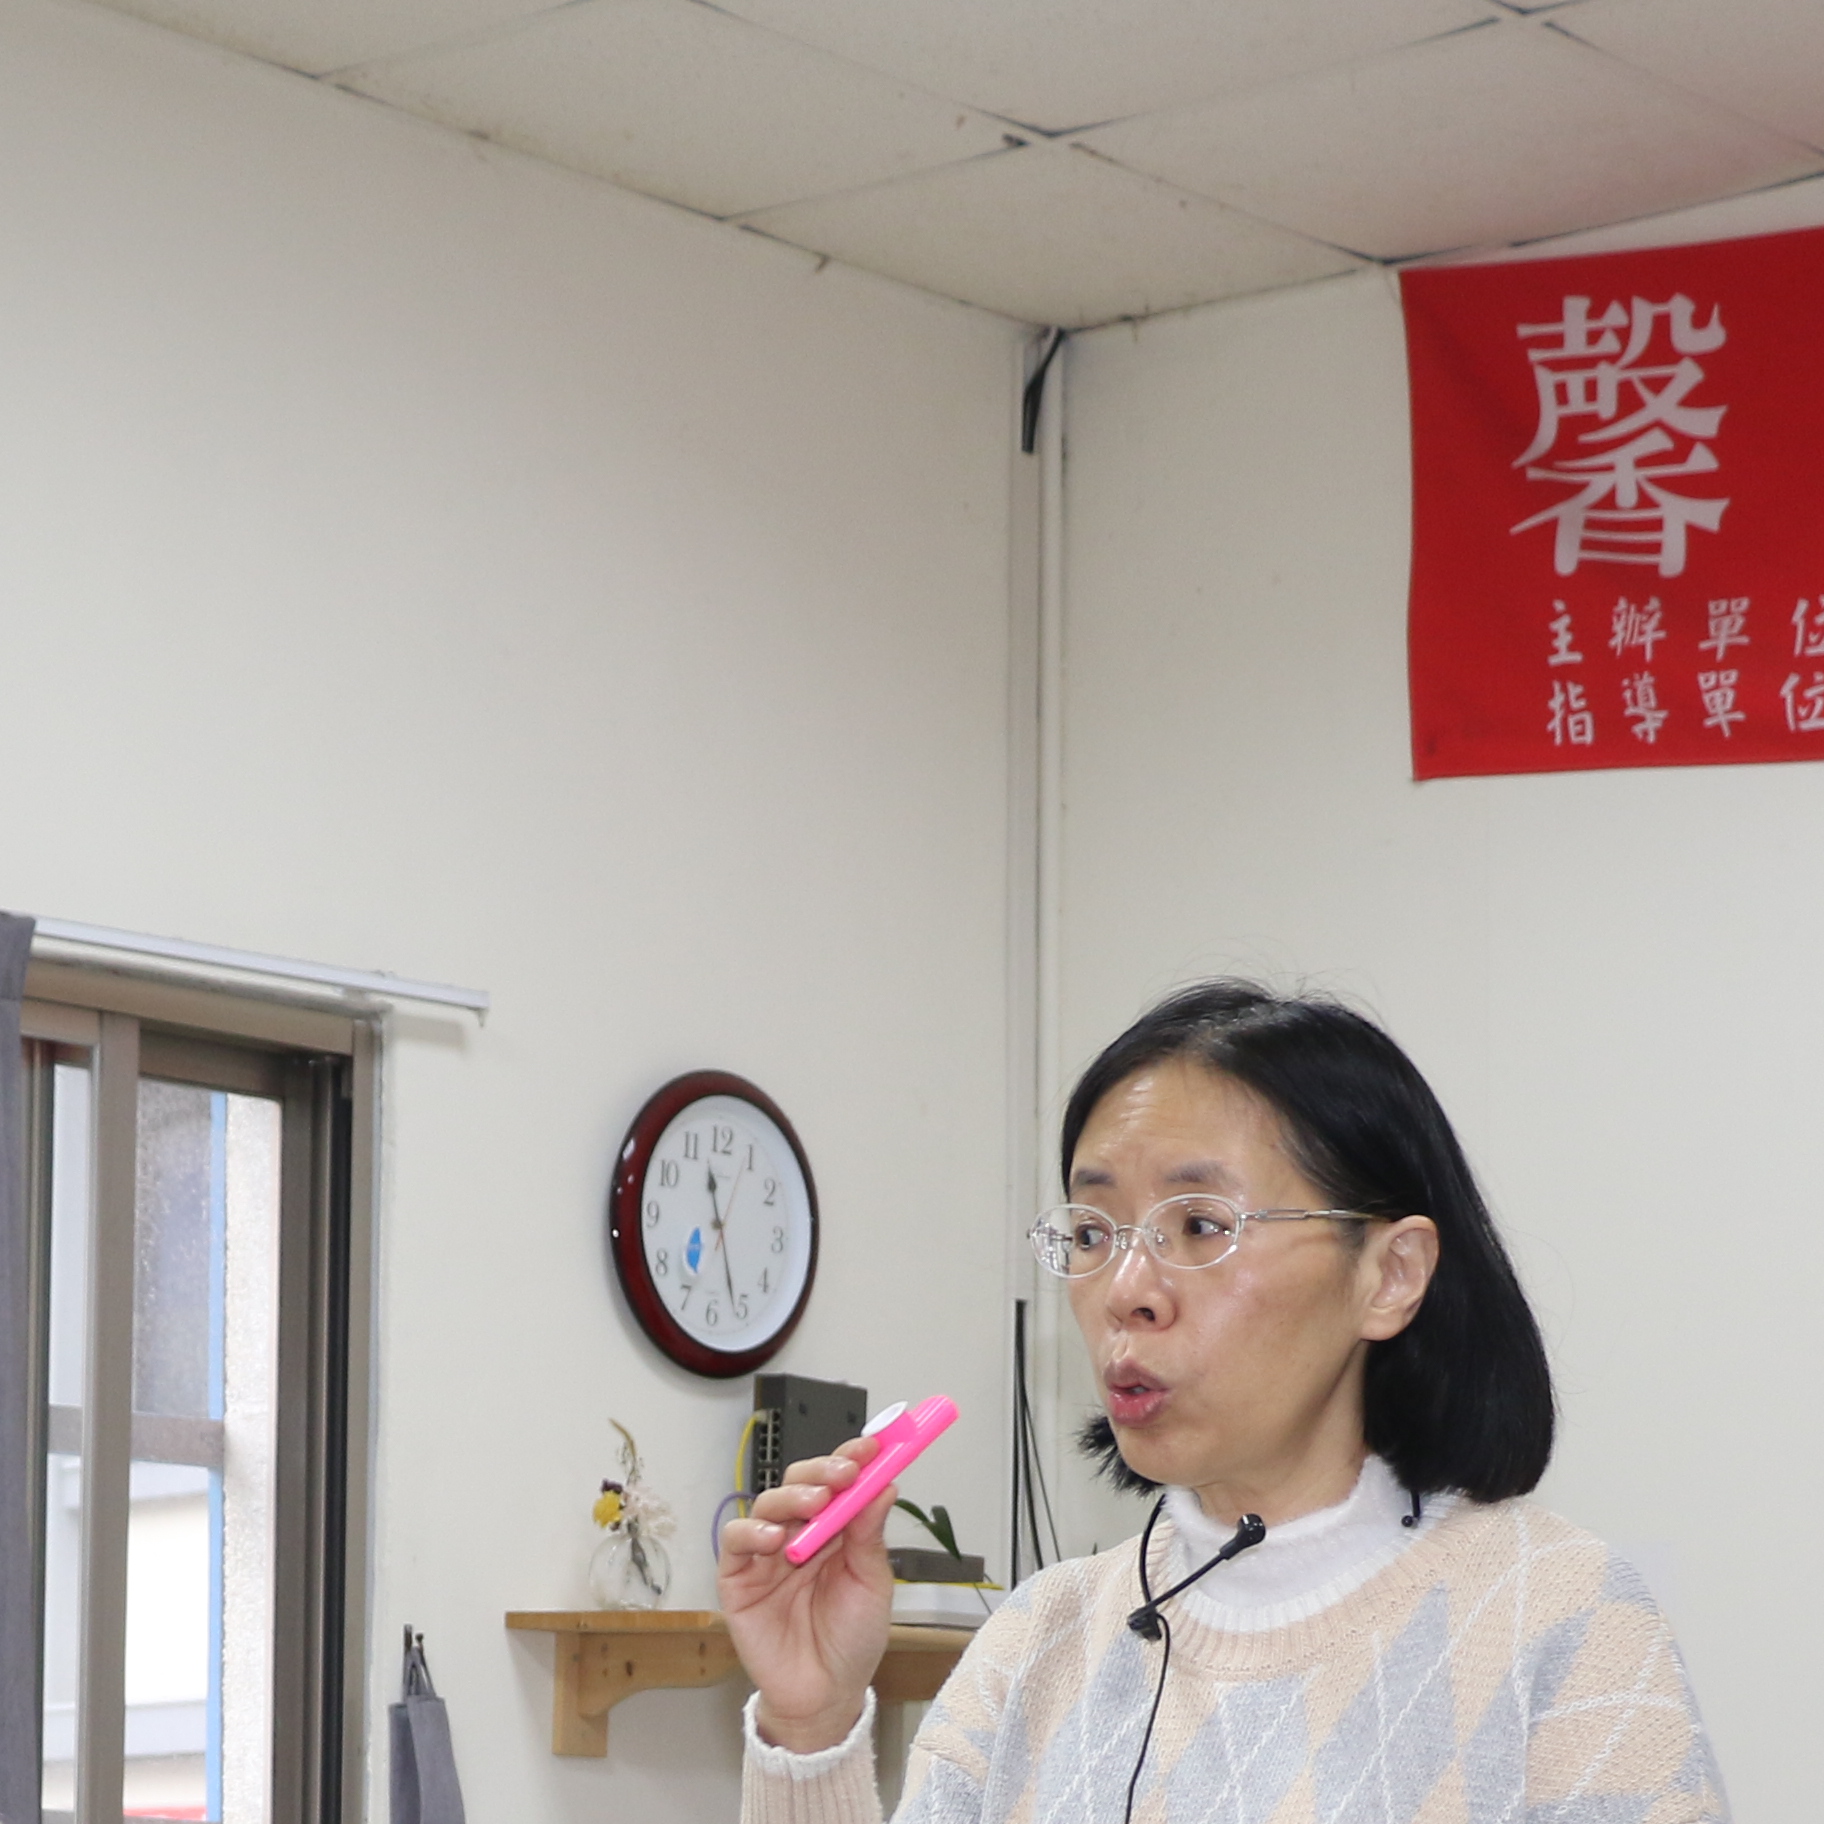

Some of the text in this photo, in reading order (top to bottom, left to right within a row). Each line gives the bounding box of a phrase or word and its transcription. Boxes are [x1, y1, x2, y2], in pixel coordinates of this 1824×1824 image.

[683, 1130, 700, 1161] 11
[711, 1125, 734, 1156] 12
[747, 1144, 755, 1172] 1
[660, 1159, 680, 1189] 10
[764, 1178, 776, 1206] 2
[646, 1201, 661, 1229] 9
[771, 1226, 784, 1254] 3
[655, 1248, 669, 1277] 8
[758, 1266, 771, 1294] 4
[680, 1284, 692, 1312] 7
[736, 1294, 749, 1321] 5
[705, 1299, 718, 1327] 6
